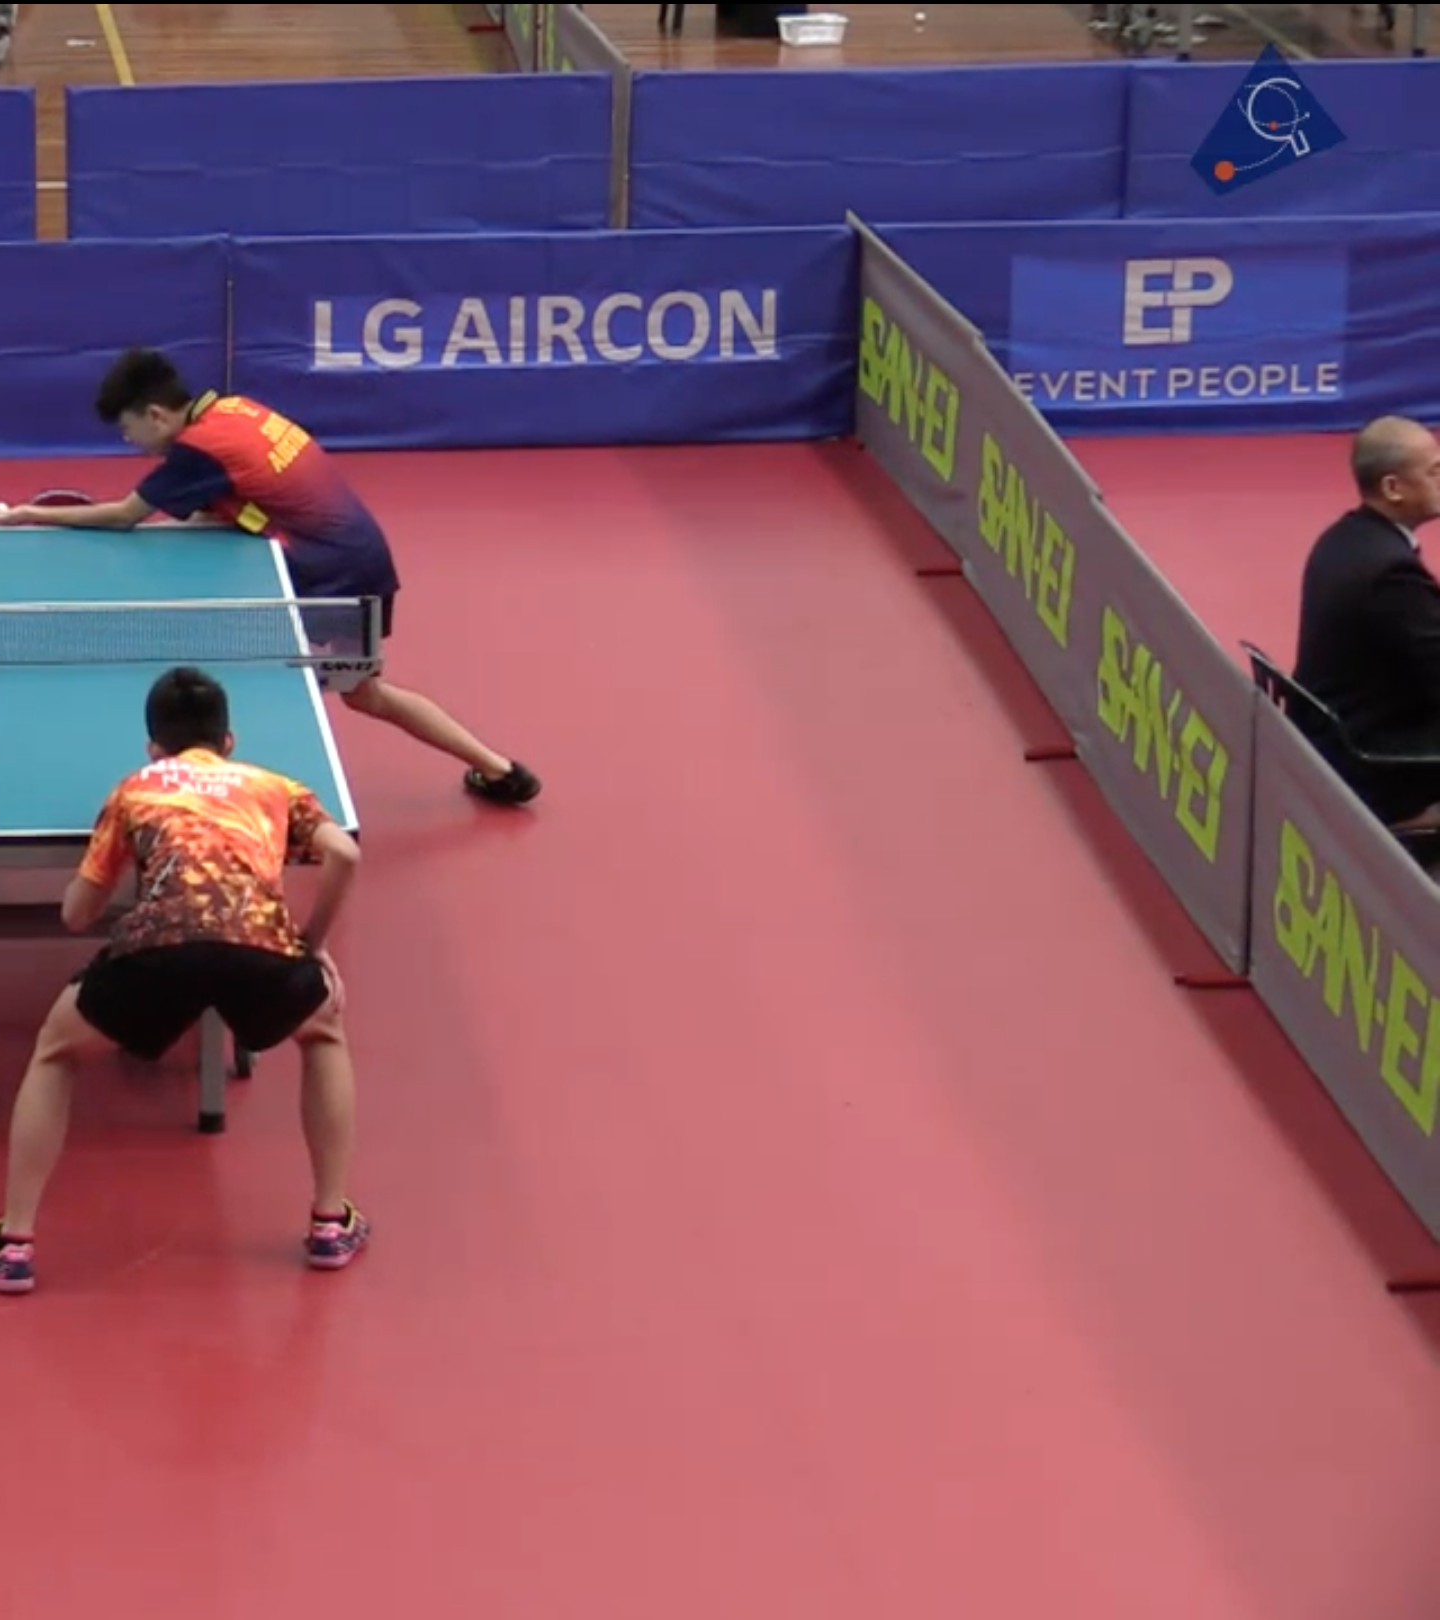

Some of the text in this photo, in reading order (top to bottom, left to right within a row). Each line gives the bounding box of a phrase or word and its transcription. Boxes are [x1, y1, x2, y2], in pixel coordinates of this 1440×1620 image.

[312, 288, 778, 369] LG AIRCON
[1123, 257, 1233, 345] EP
[1168, 361, 1340, 398] PEOPLE
